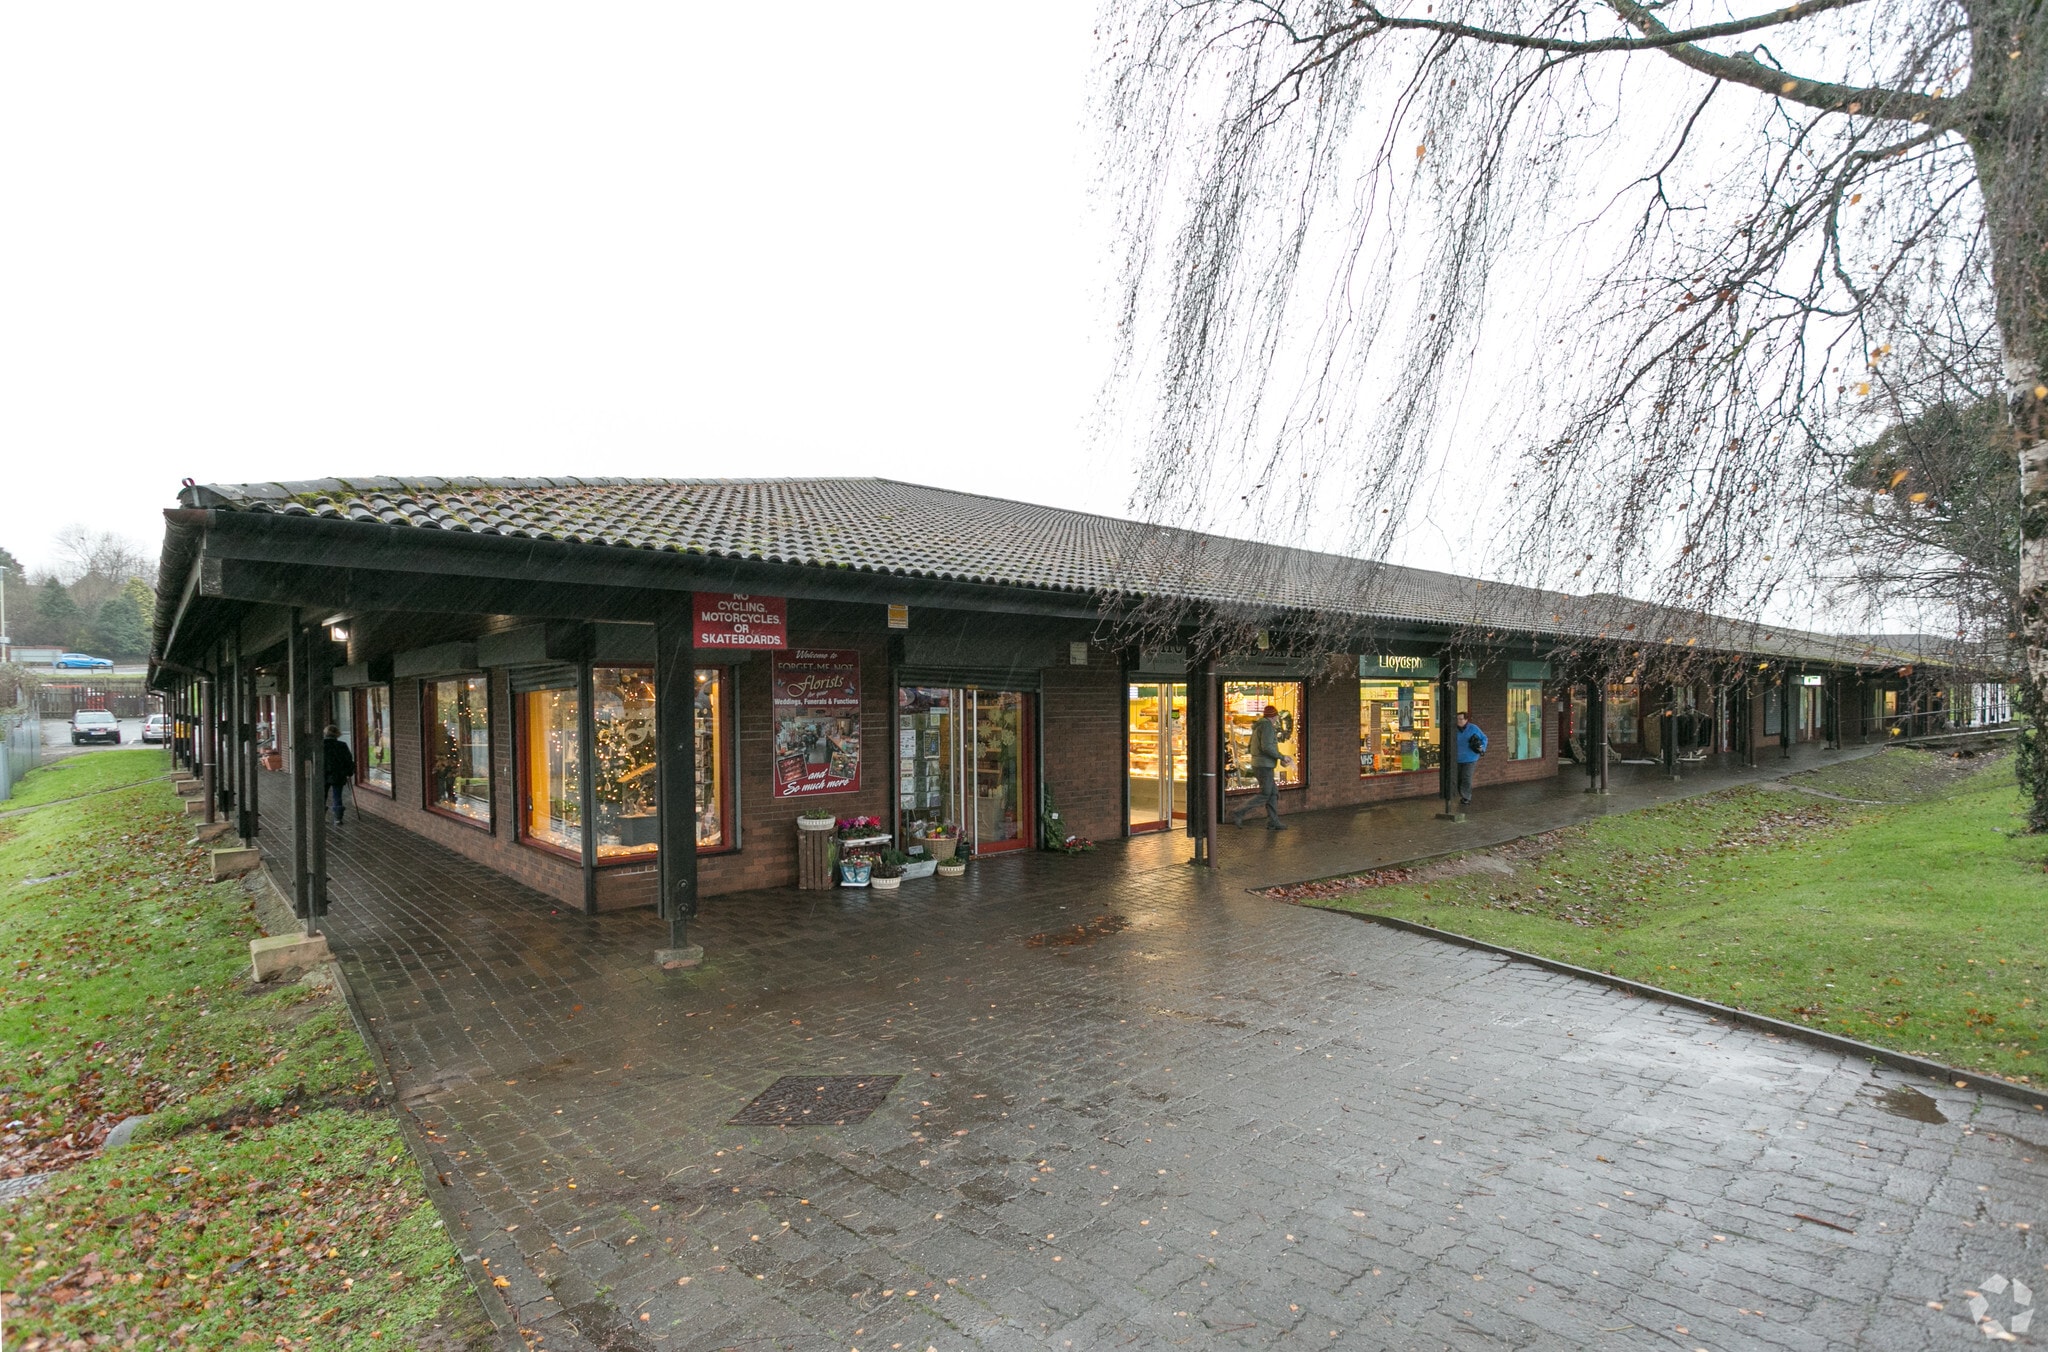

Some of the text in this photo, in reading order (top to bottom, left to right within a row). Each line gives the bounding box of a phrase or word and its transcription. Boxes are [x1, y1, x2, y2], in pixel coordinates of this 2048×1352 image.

[734, 624, 749, 633] OR
[701, 633, 783, 645] SKATEBOARDS.
[796, 650, 828, 659] Welcome
[774, 698, 803, 706] Weddings,
[808, 768, 828, 780] and
[783, 779, 850, 796] So much more
